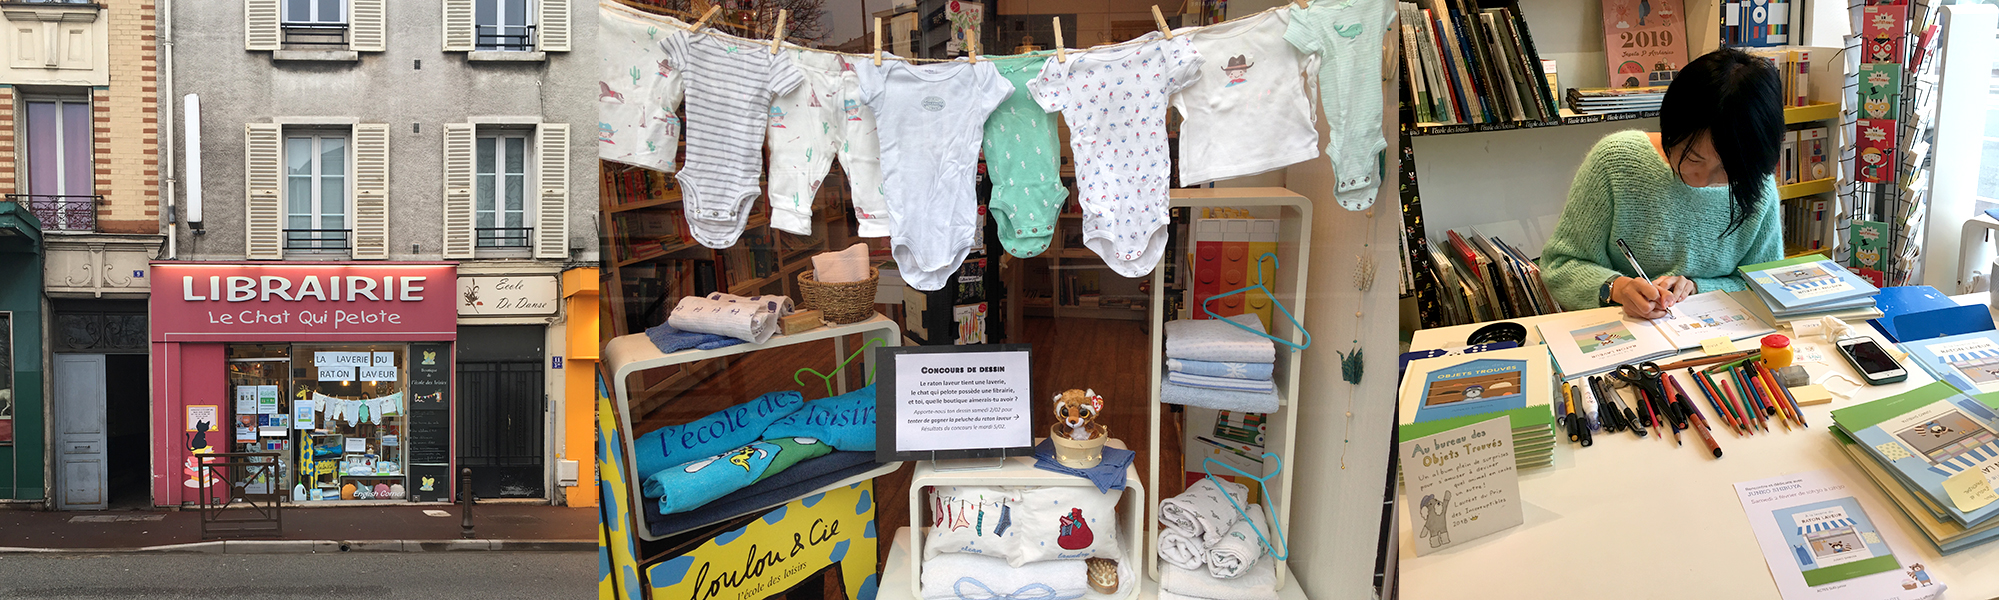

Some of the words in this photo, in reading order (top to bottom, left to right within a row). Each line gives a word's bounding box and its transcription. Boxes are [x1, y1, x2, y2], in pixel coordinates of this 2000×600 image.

[1620, 30, 1673, 48] 2019
[182, 275, 427, 302] LIBRAIRIE
[496, 297, 512, 310] De
[515, 296, 548, 309] Danse
[208, 310, 234, 325] Le
[239, 309, 291, 325] Chat
[298, 310, 328, 327] Qui
[334, 310, 402, 329] Pelote
[316, 355, 327, 364] LA
[336, 355, 369, 364] LAVERIE
[375, 355, 388, 364] DU
[320, 370, 350, 378] RATON
[361, 370, 395, 378] LAVEUR
[921, 366, 964, 374] CONCOURS
[1437, 371, 1472, 380] OBJETS
[958, 388, 980, 396] possède
[757, 389, 801, 418] des
[943, 397, 968, 405] boutique
[659, 406, 751, 458] l'école
[1412, 443, 1431, 458] Au
[1434, 435, 1467, 451] bureau
[1471, 429, 1487, 440] des
[1422, 449, 1460, 467] Objets
[1463, 438, 1503, 456] Trouvés
[1432, 468, 1454, 478] album
[1456, 462, 1472, 472] plein
[1482, 451, 1509, 463] surprises
[1420, 482, 1434, 492] pour
[1476, 461, 1500, 473] deviner
[1454, 480, 1466, 489] quel
[1468, 473, 1487, 484] animal
[353, 490, 379, 500] English
[1747, 488, 1772, 497] JUNKO
[1772, 484, 1802, 493] SHIBUYA
[1751, 496, 1774, 504] Samedi
[1451, 511, 1462, 519] des
[1801, 516, 1821, 524] RATON
[1822, 512, 1842, 520] LAVEUR
[790, 532, 805, 558] &
[809, 517, 841, 546] Cie
[737, 583, 765, 600] l'école
[767, 574, 781, 588] des
[783, 561, 807, 579] loisirs
